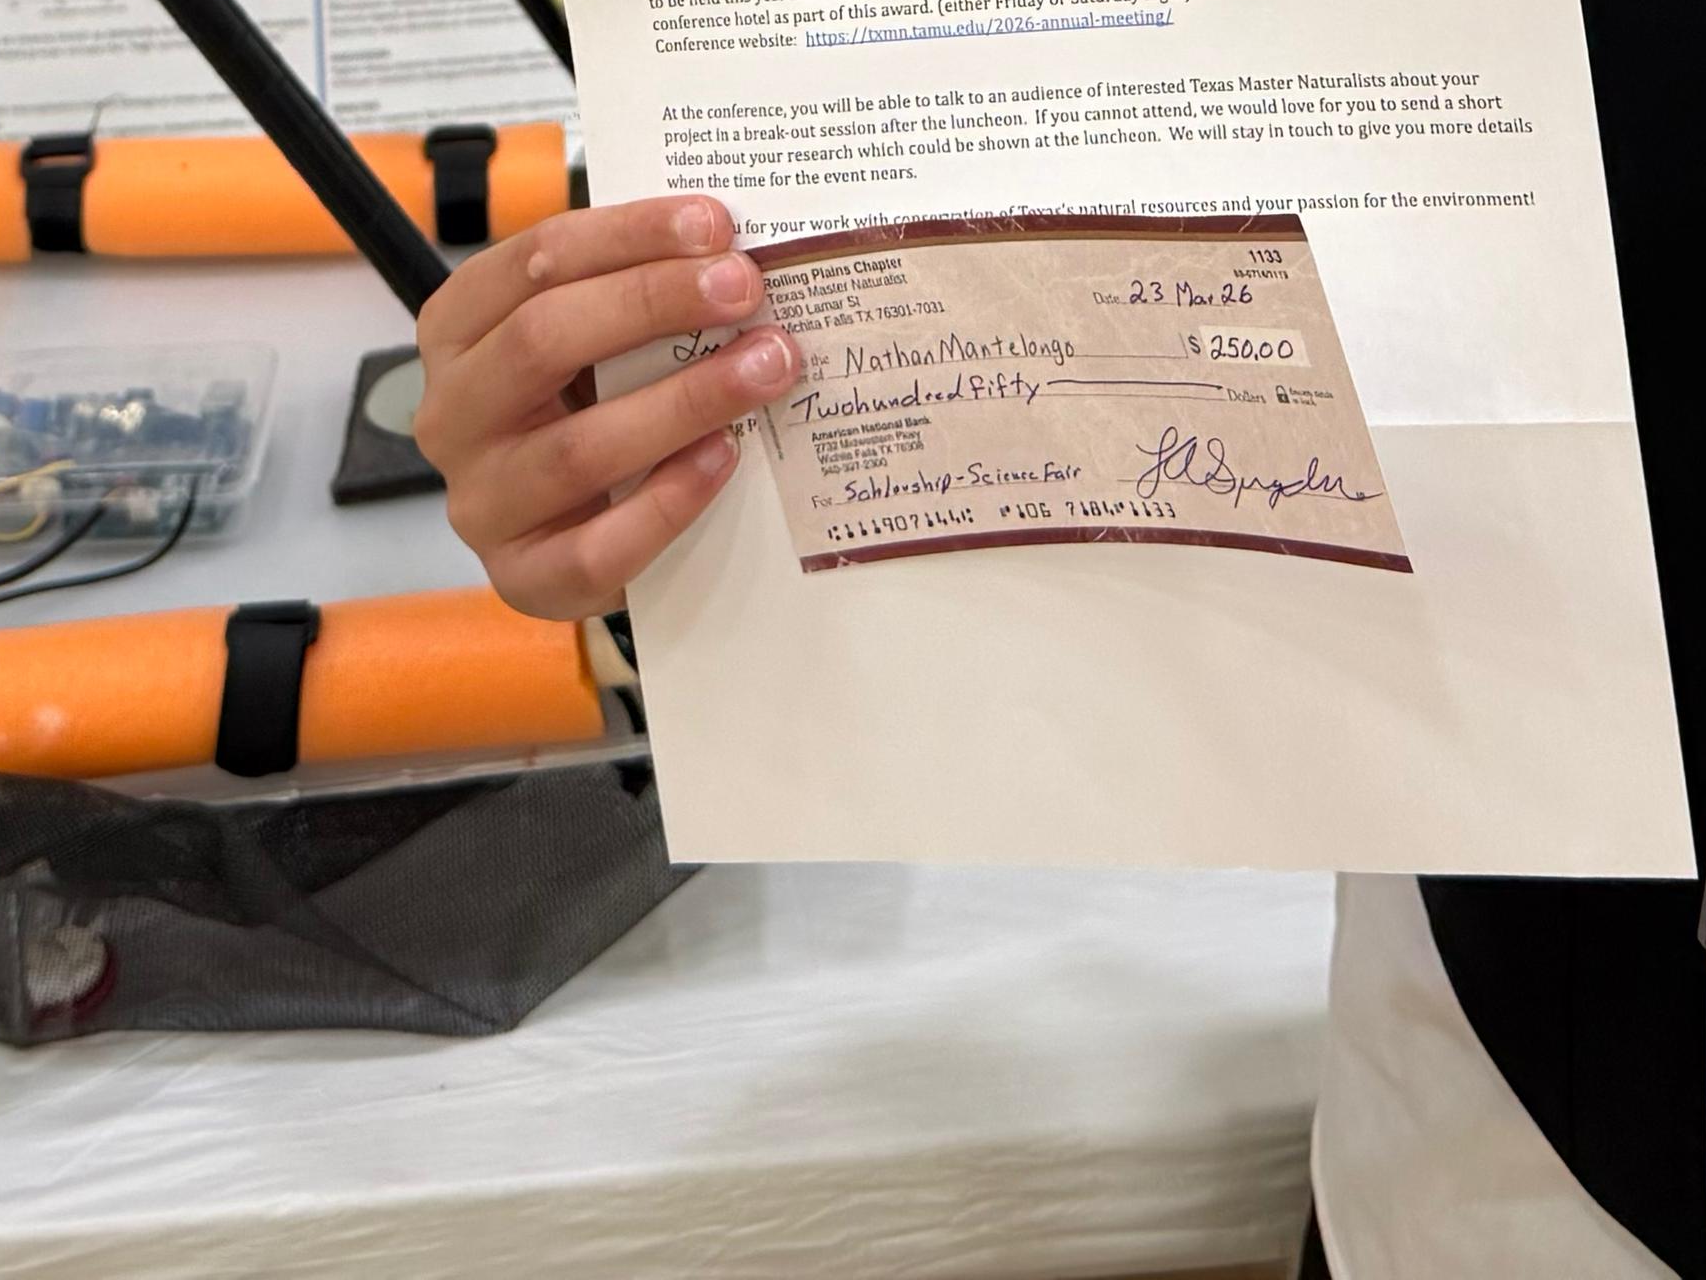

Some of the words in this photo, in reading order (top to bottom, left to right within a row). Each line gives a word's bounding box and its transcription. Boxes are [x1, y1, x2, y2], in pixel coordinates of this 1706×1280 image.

[655, 36, 735, 54] Conference
[738, 33, 797, 49] website:
[805, 7, 1175, 48] https://txmn.tamu.edu/2026-annual-meeting/
[1248, 250, 1283, 263] 1133
[763, 269, 809, 290] Rolling
[811, 263, 852, 284] Plains
[853, 256, 903, 280] Chapter
[767, 286, 806, 306] Texas
[807, 280, 848, 300] Master
[851, 272, 908, 293] Naturalist
[1129, 281, 1164, 303] 23
[1176, 282, 1214, 307] Mar
[1221, 284, 1253, 304] 26
[773, 304, 803, 321] 1300
[805, 297, 846, 317] Lamar
[825, 312, 854, 329] Falls
[857, 308, 873, 323] TX
[877, 300, 946, 320] 76301-7031
[1189, 335, 1202, 354] $
